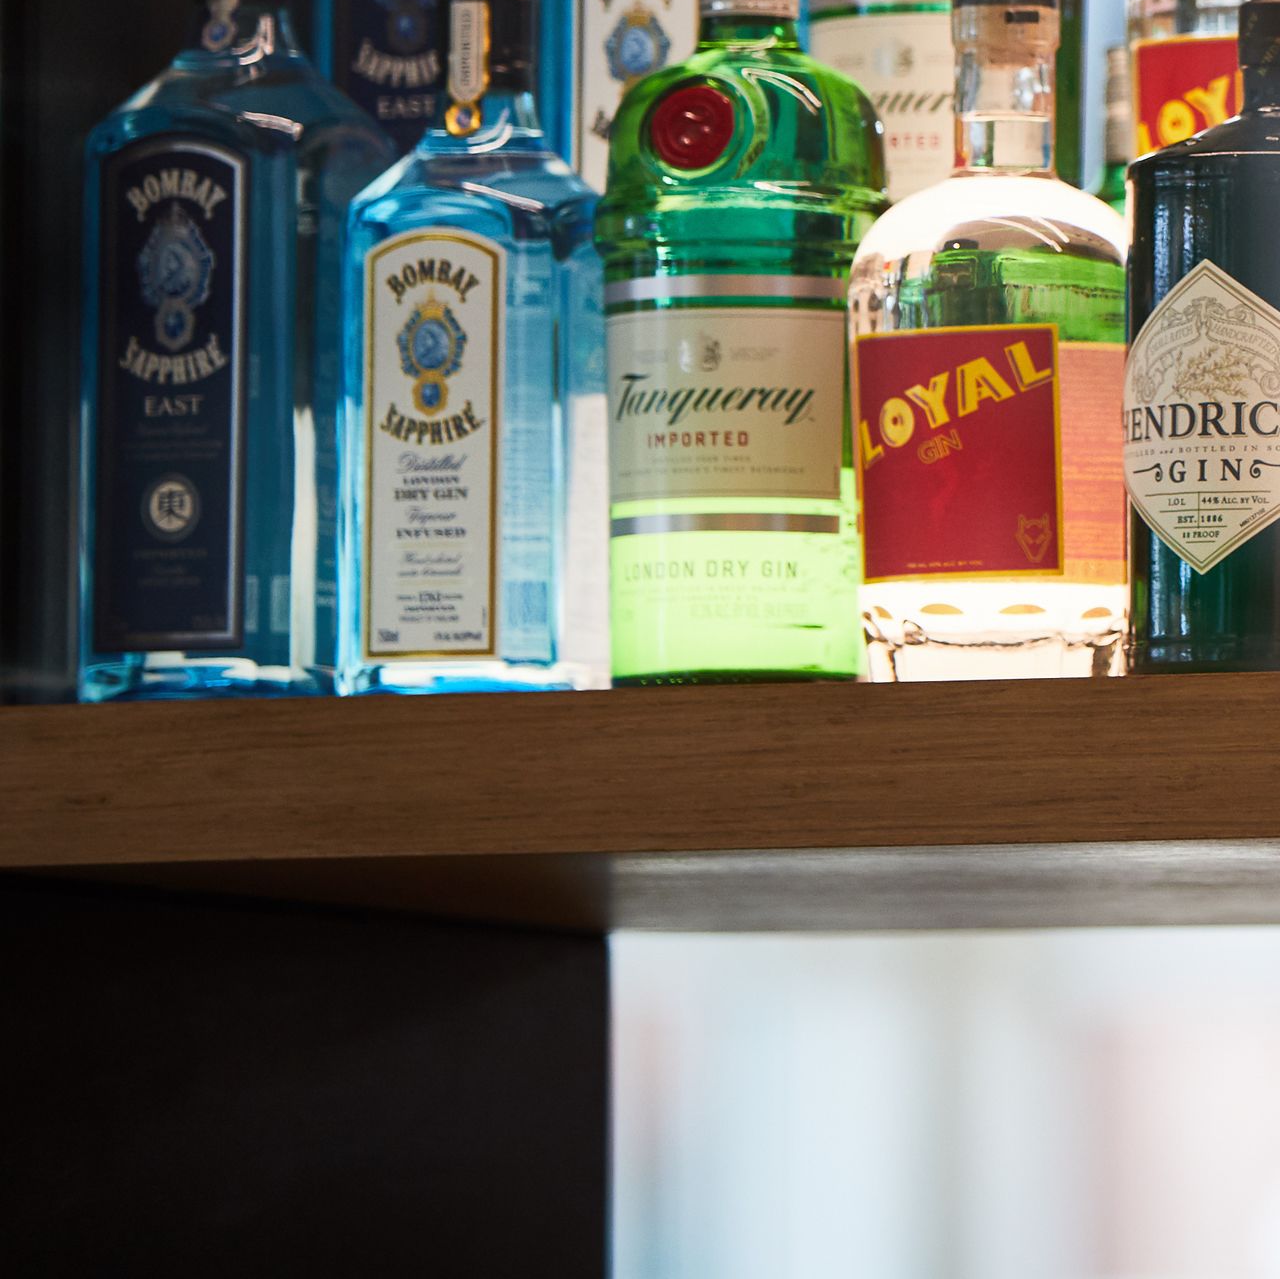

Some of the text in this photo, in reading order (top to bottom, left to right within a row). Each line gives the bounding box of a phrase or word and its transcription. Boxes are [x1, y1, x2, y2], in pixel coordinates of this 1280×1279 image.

[376, 95, 435, 118] EAST
[126, 169, 228, 222] BOMBAY
[386, 258, 479, 304] BOMBAY
[119, 332, 228, 384] SAPPHIRE
[144, 394, 203, 417] EAST
[616, 373, 815, 426] Tanqueray
[859, 341, 1054, 469] LOYAL
[380, 400, 486, 445] SAPPHIRE
[647, 430, 749, 449] IMPORTED
[917, 428, 962, 464] GIN
[1178, 445, 1235, 453] BOTTLED
[1169, 458, 1243, 483] GIN
[395, 488, 468, 500] DRY GIN
[625, 559, 798, 582] LONDON DRY GIN
